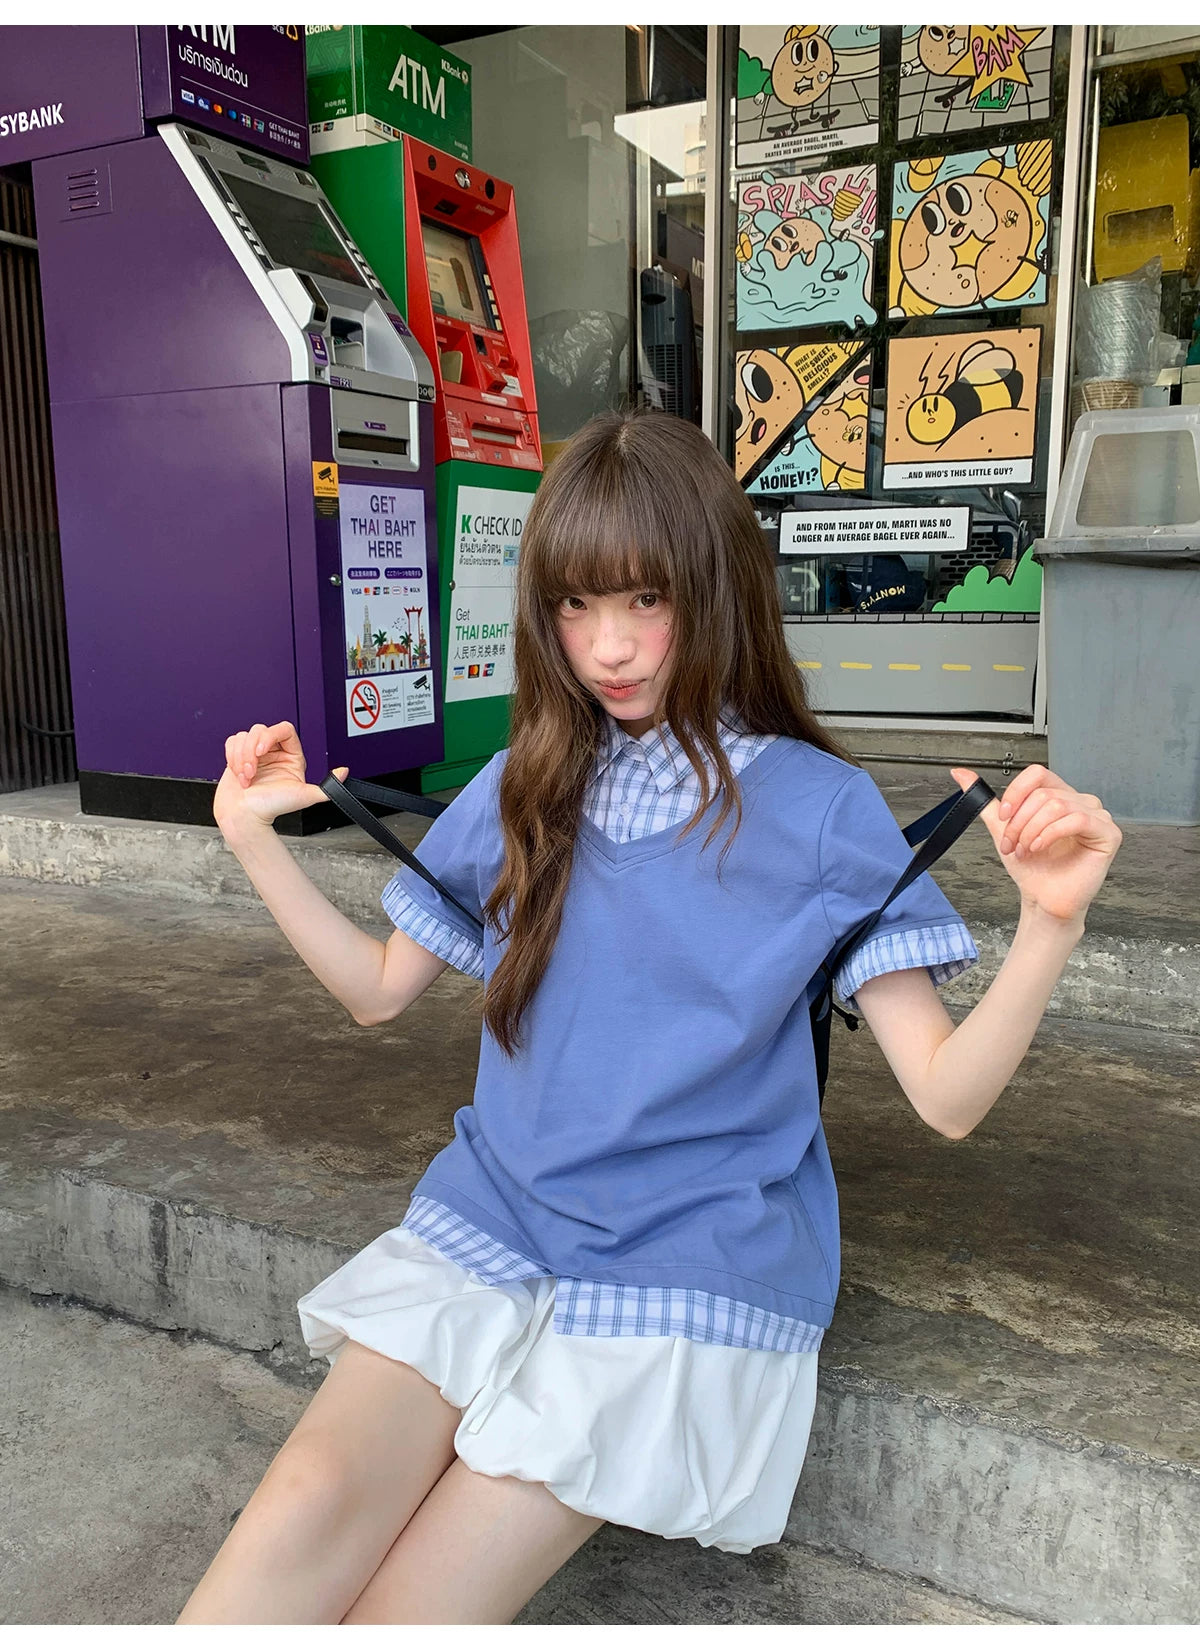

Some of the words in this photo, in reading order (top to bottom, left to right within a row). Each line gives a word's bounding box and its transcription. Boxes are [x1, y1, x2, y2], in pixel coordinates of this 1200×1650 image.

[972, 26, 1026, 79] BAM
[178, 44, 249, 88] บริการเงินด่วน
[441, 58, 462, 79] KBank
[388, 53, 446, 119] ATM
[764, 150, 782, 159] SKATES
[782, 148, 792, 156] HIS
[792, 146, 803, 154] WAY
[804, 143, 828, 153] THROUGH
[781, 138, 803, 148] AVERAGE
[794, 353, 810, 367] WHAT
[809, 348, 817, 356] IS
[802, 352, 838, 382] DELICIOUS
[797, 362, 810, 374] THIS
[760, 467, 819, 490] HONEY!?
[924, 469, 948, 478] WHO'S
[950, 469, 967, 477] THIS
[968, 468, 991, 476] LITTLE
[993, 467, 1013, 475] GUY?
[369, 494, 396, 515] GET
[350, 517, 380, 536] THAI
[384, 519, 416, 537] BAHT
[461, 514, 472, 534] K
[474, 515, 510, 536] CHECK
[511, 518, 523, 536] ID
[796, 523, 812, 531] AND
[814, 522, 836, 531] FROM
[838, 521, 857, 530] THAT
[859, 521, 874, 530] DAY
[875, 520, 890, 530] ON,
[891, 519, 917, 529] MARTI
[919, 519, 938, 528] WAS
[939, 518, 952, 527] NO
[792, 534, 822, 543] LONGER
[824, 533, 834, 542] AN
[836, 532, 870, 542] AVERAGE
[873, 531, 898, 541] BAGEL
[900, 531, 920, 540] EVER
[921, 530, 955, 539] AGAIN...
[367, 540, 402, 558] HERE
[350, 587, 362, 595] VISA
[860, 585, 906, 610] MONTY'S
[456, 607, 470, 621] Get
[455, 625, 480, 640] THAI
[481, 623, 509, 639] BAHT
